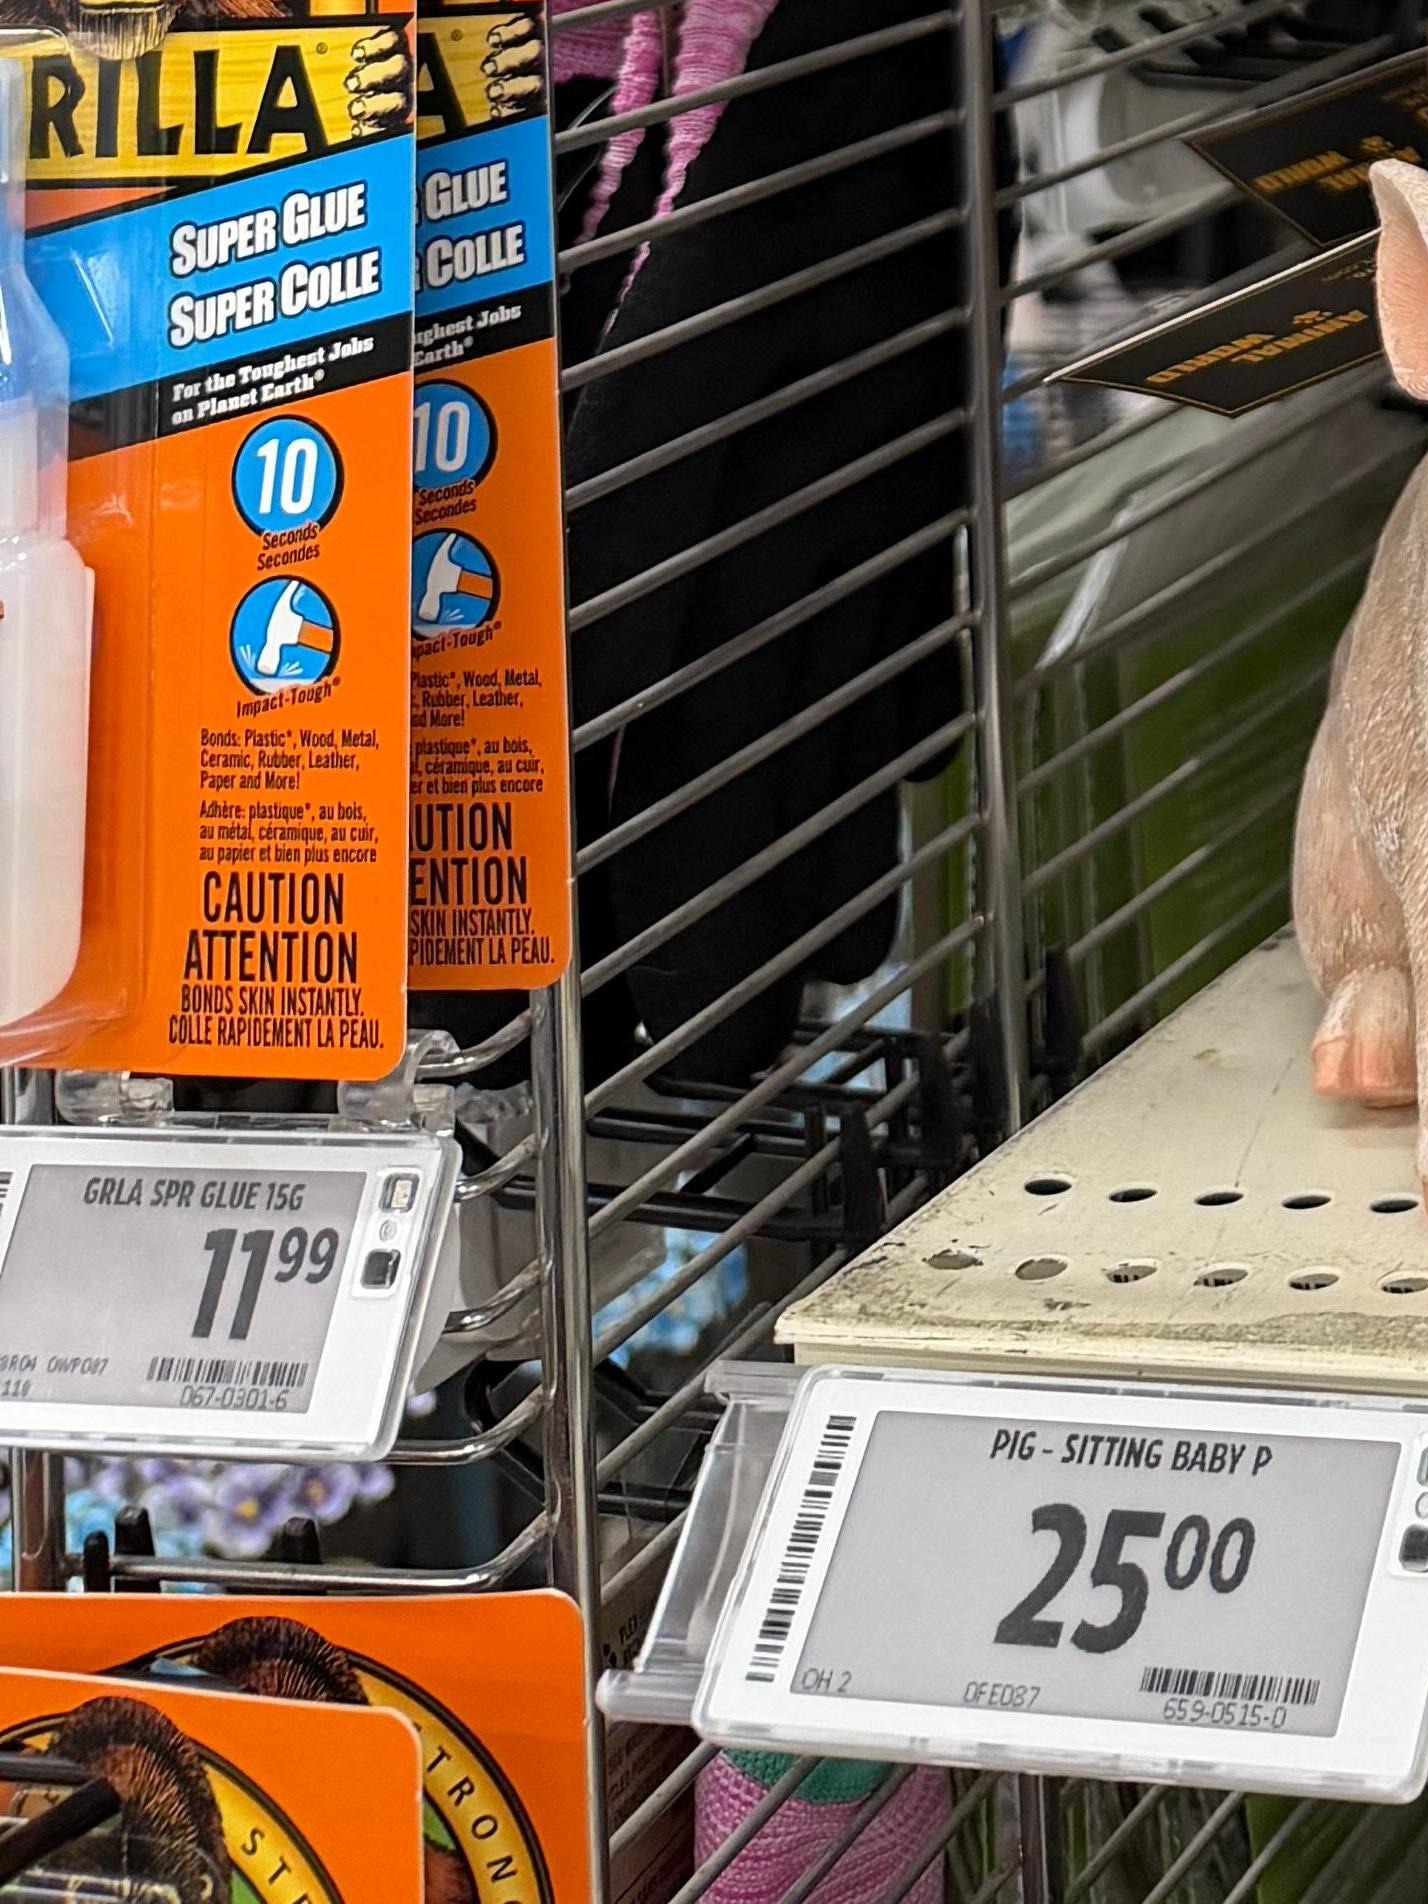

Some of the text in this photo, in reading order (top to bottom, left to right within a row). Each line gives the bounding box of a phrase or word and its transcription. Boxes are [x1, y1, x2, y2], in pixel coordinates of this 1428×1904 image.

[425, 161, 508, 220] GLUE
[172, 183, 366, 276] SUPER GLUE
[426, 225, 524, 286] COLLE
[170, 250, 380, 348] SUPER COLLE
[1230, 307, 1369, 365] ANIMAL
[172, 334, 374, 404] For the Toughest Jobs
[1145, 332, 1275, 384] WORLD
[197, 389, 257, 423] Planet
[414, 398, 469, 474] 10
[256, 437, 318, 515] 10
[257, 542, 321, 571] Secondes
[262, 521, 320, 551] Seconds
[201, 771, 235, 793] Paper
[239, 772, 262, 790] and
[333, 848, 377, 863] encore
[203, 871, 345, 925] CAUTION
[451, 908, 536, 936] INSTANTLY.
[183, 929, 358, 984] ATTENTION
[511, 936, 556, 964] PEAU.
[181, 984, 365, 1018] BONDS SKIN INSTANTLY.
[168, 1015, 384, 1050] COLLE RAPIDEMENT LA PEAU.
[84, 1177, 307, 1212] GRLA SPR GLUE 15G
[989, 1429, 1274, 1478] PIG SITTING BABY P
[801, 1668, 853, 1694] OH 2
[1163, 1697, 1287, 1728] 659-0515-0
